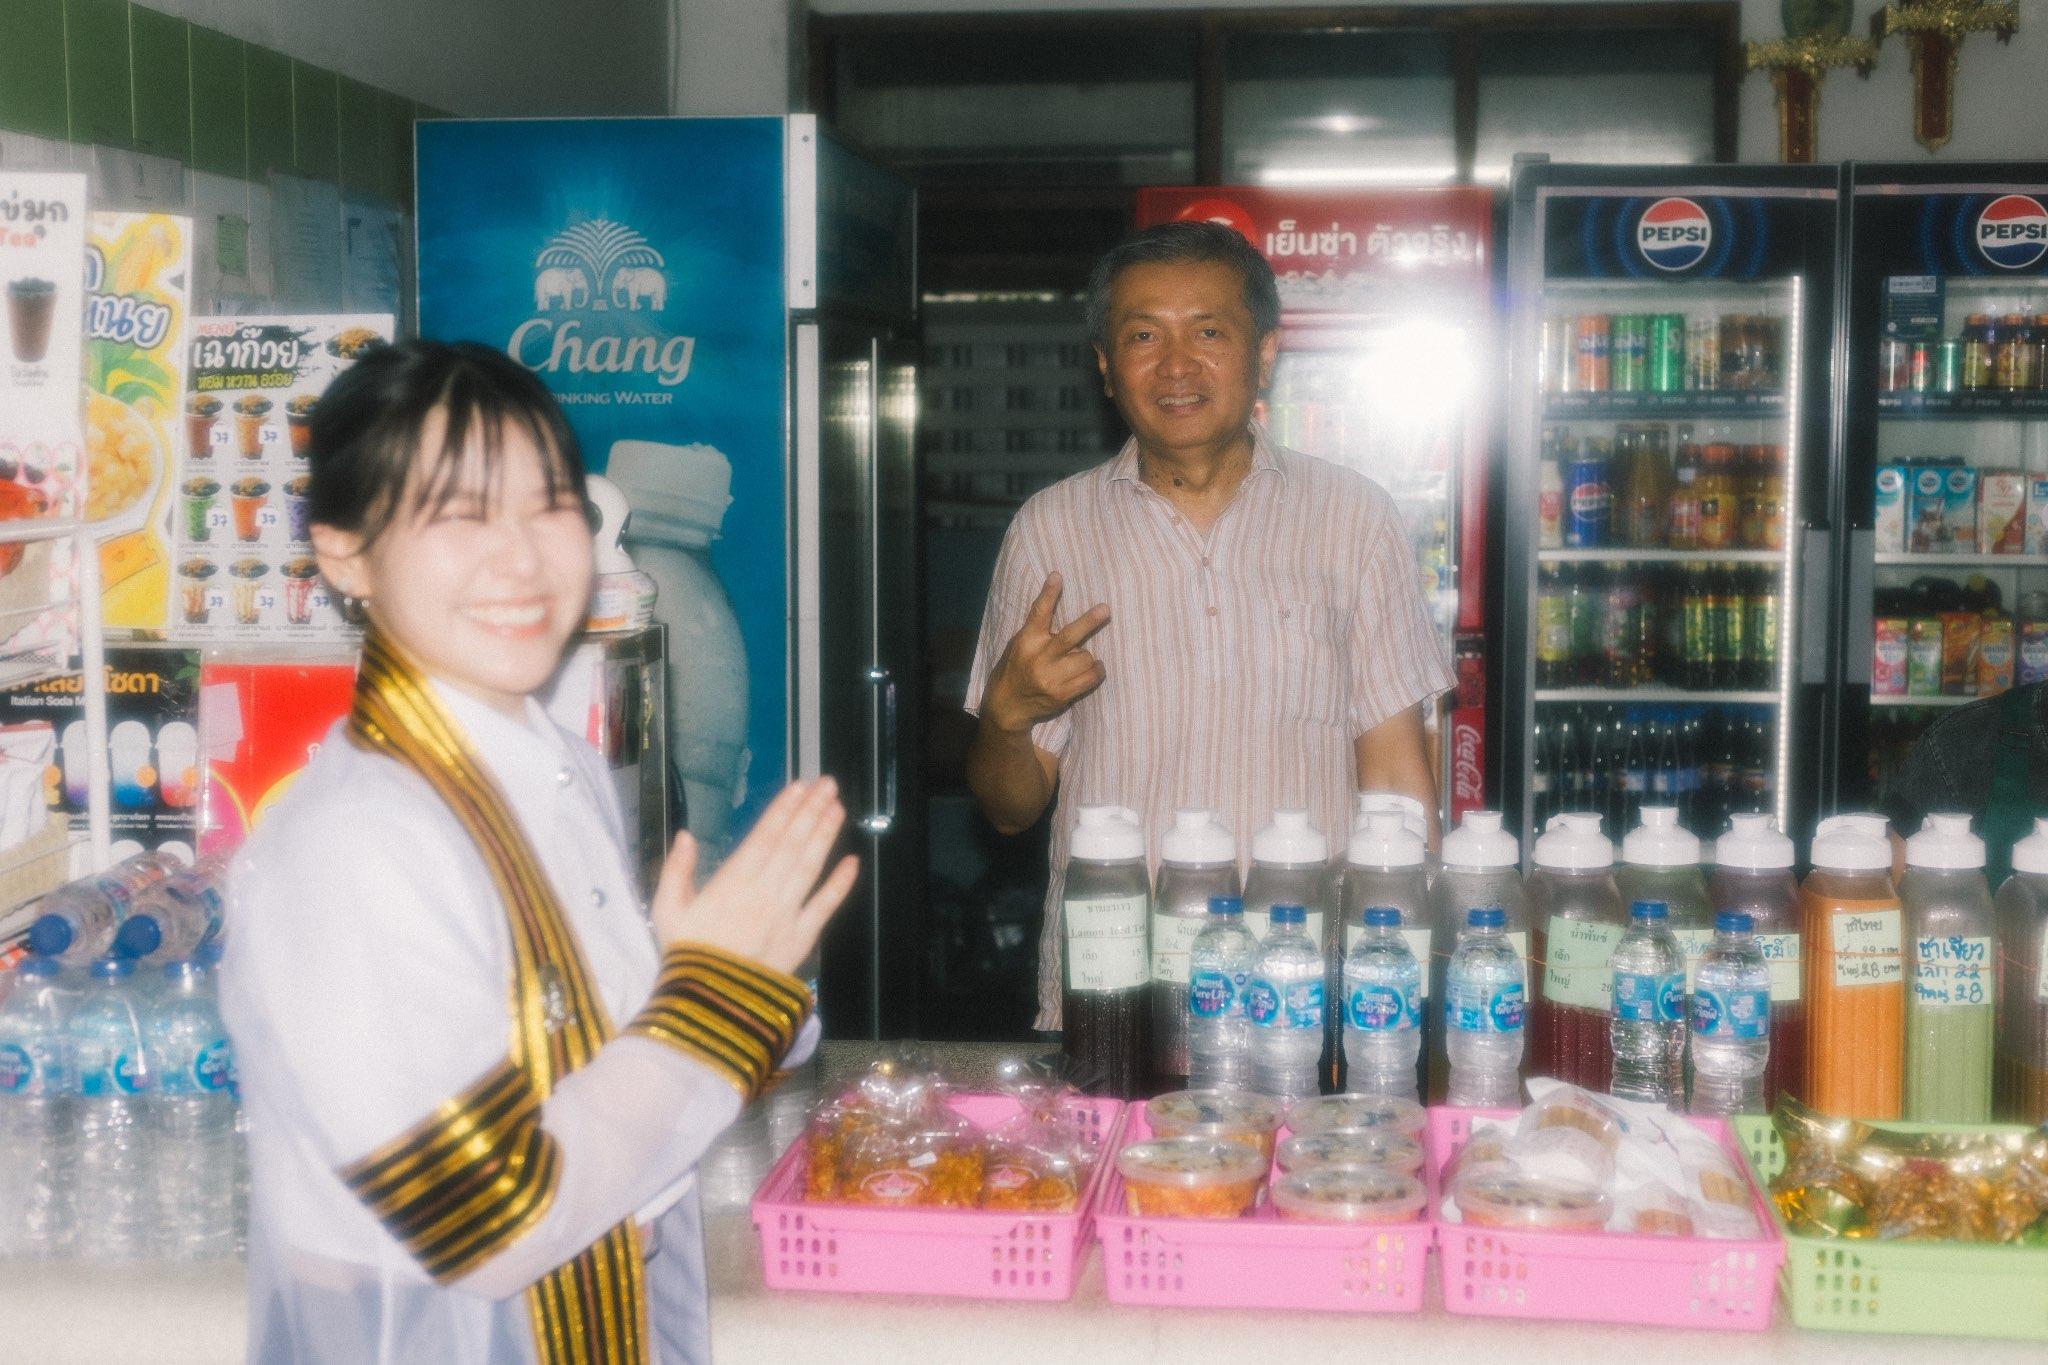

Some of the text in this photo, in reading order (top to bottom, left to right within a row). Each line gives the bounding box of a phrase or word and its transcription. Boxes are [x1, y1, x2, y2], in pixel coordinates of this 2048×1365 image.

[1265, 219, 1358, 256] เย็นซ่า
[1642, 226, 1708, 242] PEPSI
[1981, 223, 2048, 240] PEPSI
[193, 327, 299, 369] เฉาก๊วย
[507, 317, 697, 386] Chang
[553, 391, 673, 405] INKING WATER
[11, 695, 43, 706] Italian
[46, 695, 73, 706] Soda
